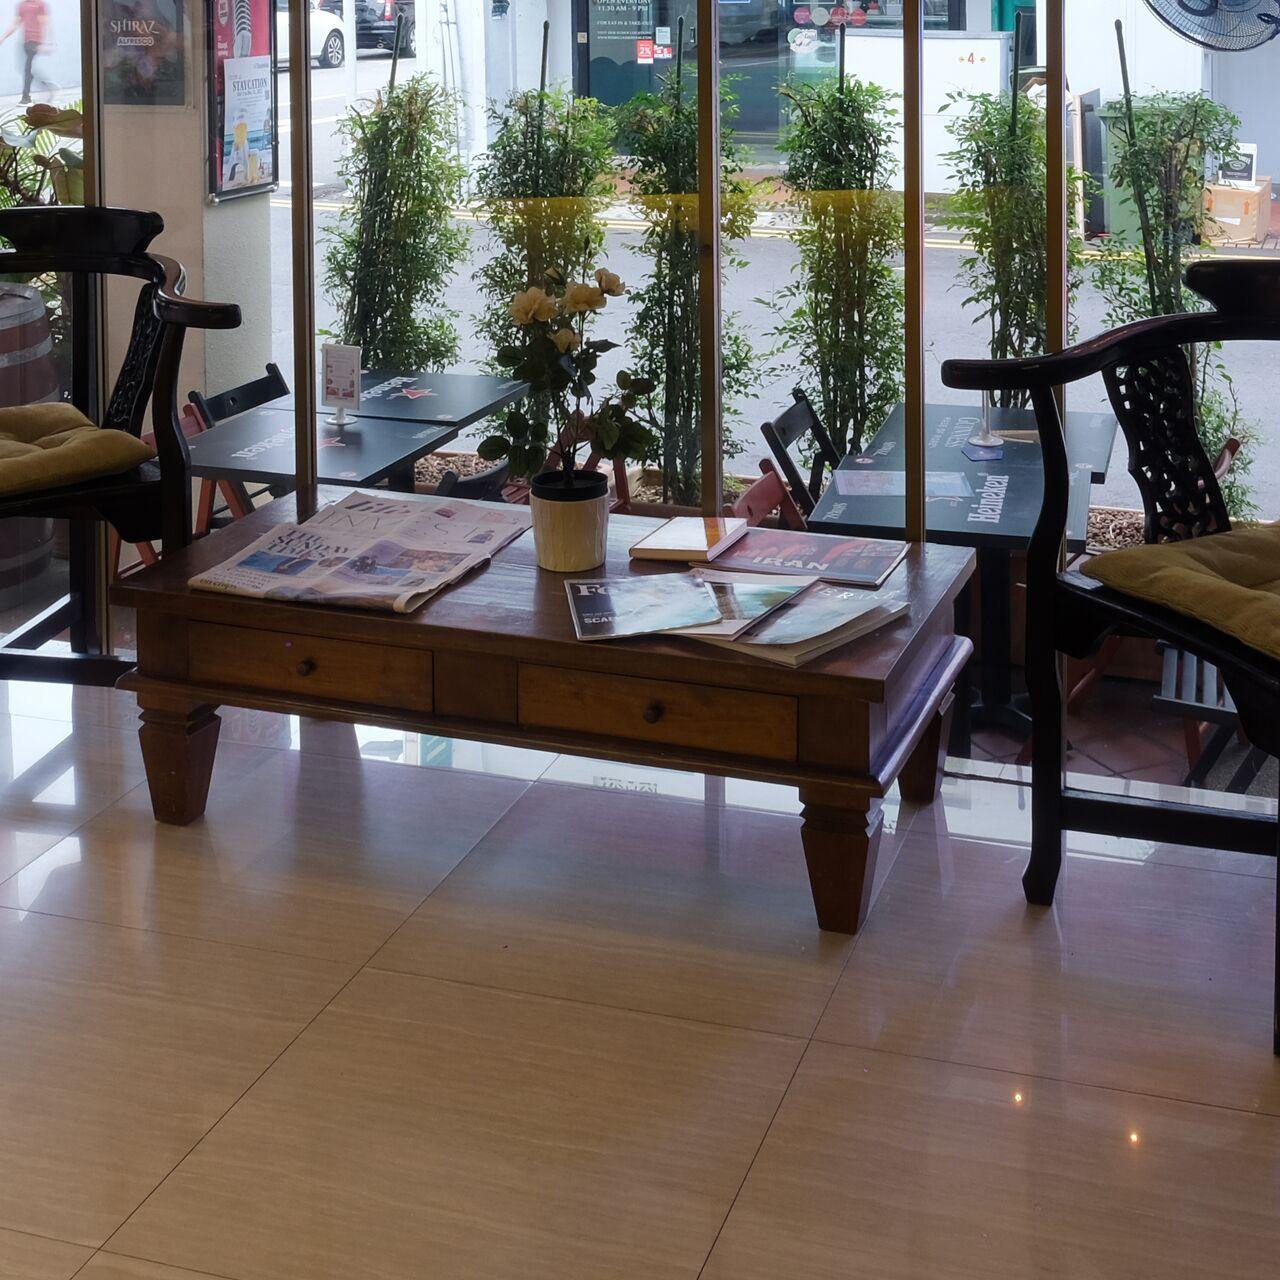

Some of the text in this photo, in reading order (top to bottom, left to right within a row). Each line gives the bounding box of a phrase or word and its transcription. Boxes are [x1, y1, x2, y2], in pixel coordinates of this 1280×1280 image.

[110, 18, 160, 34] SHIRAZ
[118, 37, 154, 45] ALFRESCO
[967, 52, 975, 64] 4
[232, 77, 268, 92] STAYCATION
[967, 474, 1010, 524] Heineken
[752, 557, 830, 571] IRAN
